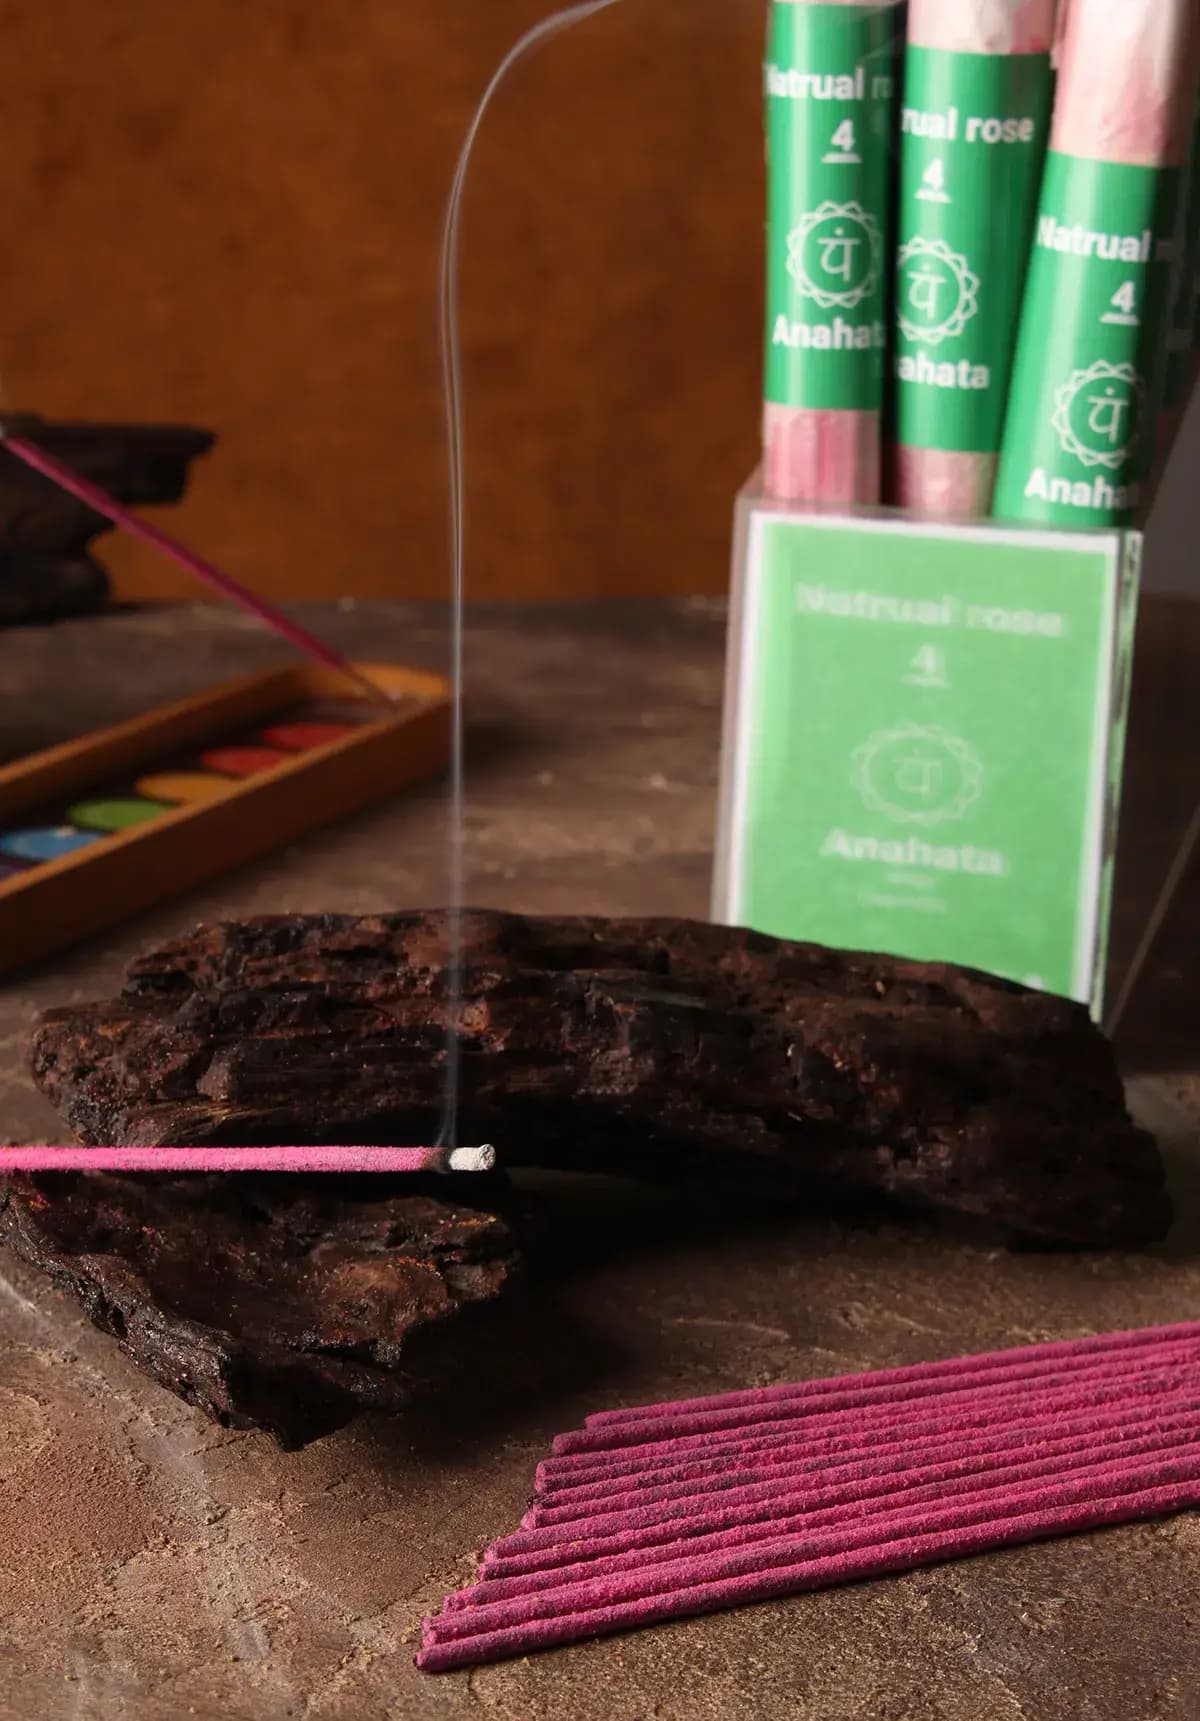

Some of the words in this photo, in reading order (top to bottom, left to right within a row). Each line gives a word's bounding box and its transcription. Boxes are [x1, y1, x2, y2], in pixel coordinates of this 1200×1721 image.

[830, 119, 856, 151] 4
[966, 117, 1034, 143] rose
[922, 158, 944, 189] 4
[1038, 217, 1151, 262] Natrual
[1110, 280, 1135, 313] 4
[821, 829, 1008, 874] Anahata
